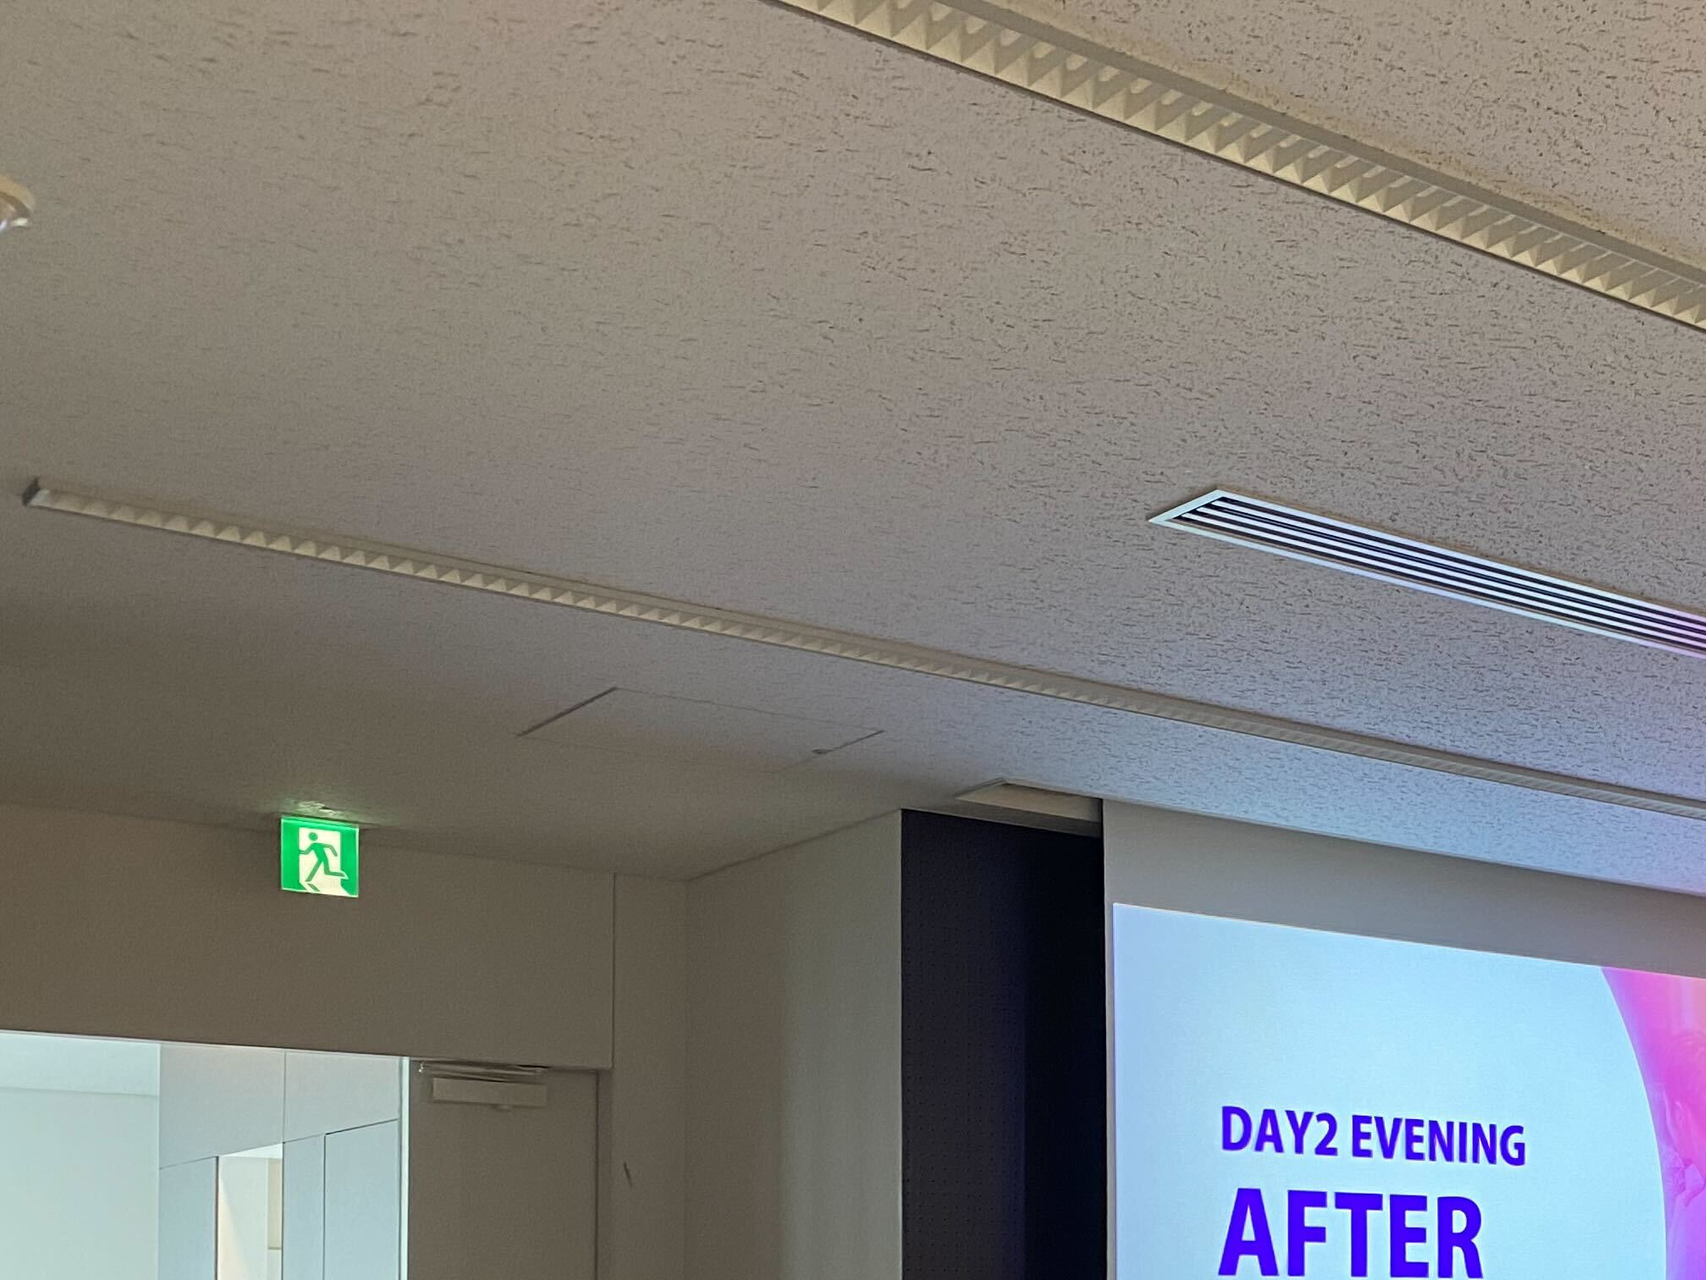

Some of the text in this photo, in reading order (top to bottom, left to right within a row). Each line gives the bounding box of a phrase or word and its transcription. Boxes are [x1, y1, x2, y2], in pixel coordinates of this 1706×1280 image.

[1220, 1105, 1527, 1166] DAY2 EVENING
[1218, 1187, 1484, 1279] AFTER
